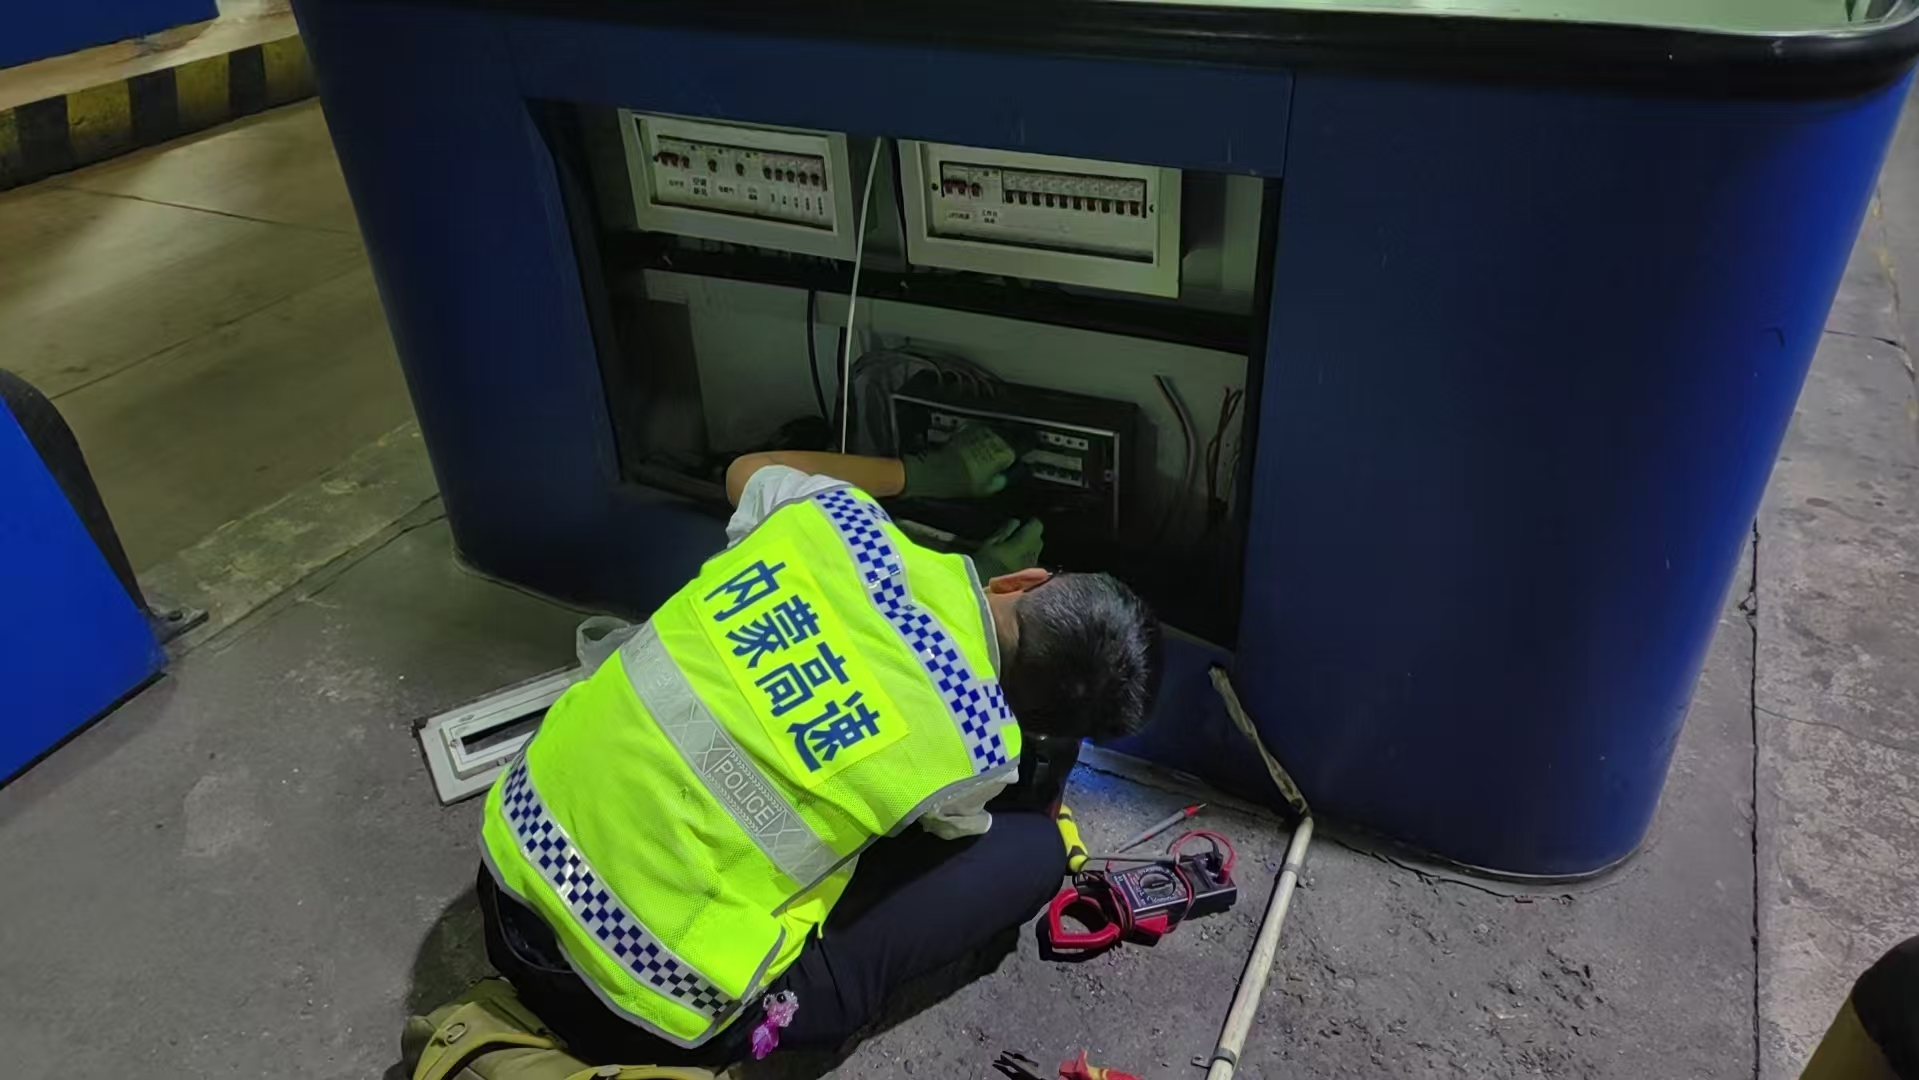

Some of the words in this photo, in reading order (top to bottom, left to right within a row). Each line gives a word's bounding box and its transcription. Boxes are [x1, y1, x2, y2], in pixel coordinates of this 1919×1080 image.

[703, 560, 881, 773] 内蒙高速
[714, 758, 776, 827] POLICE
